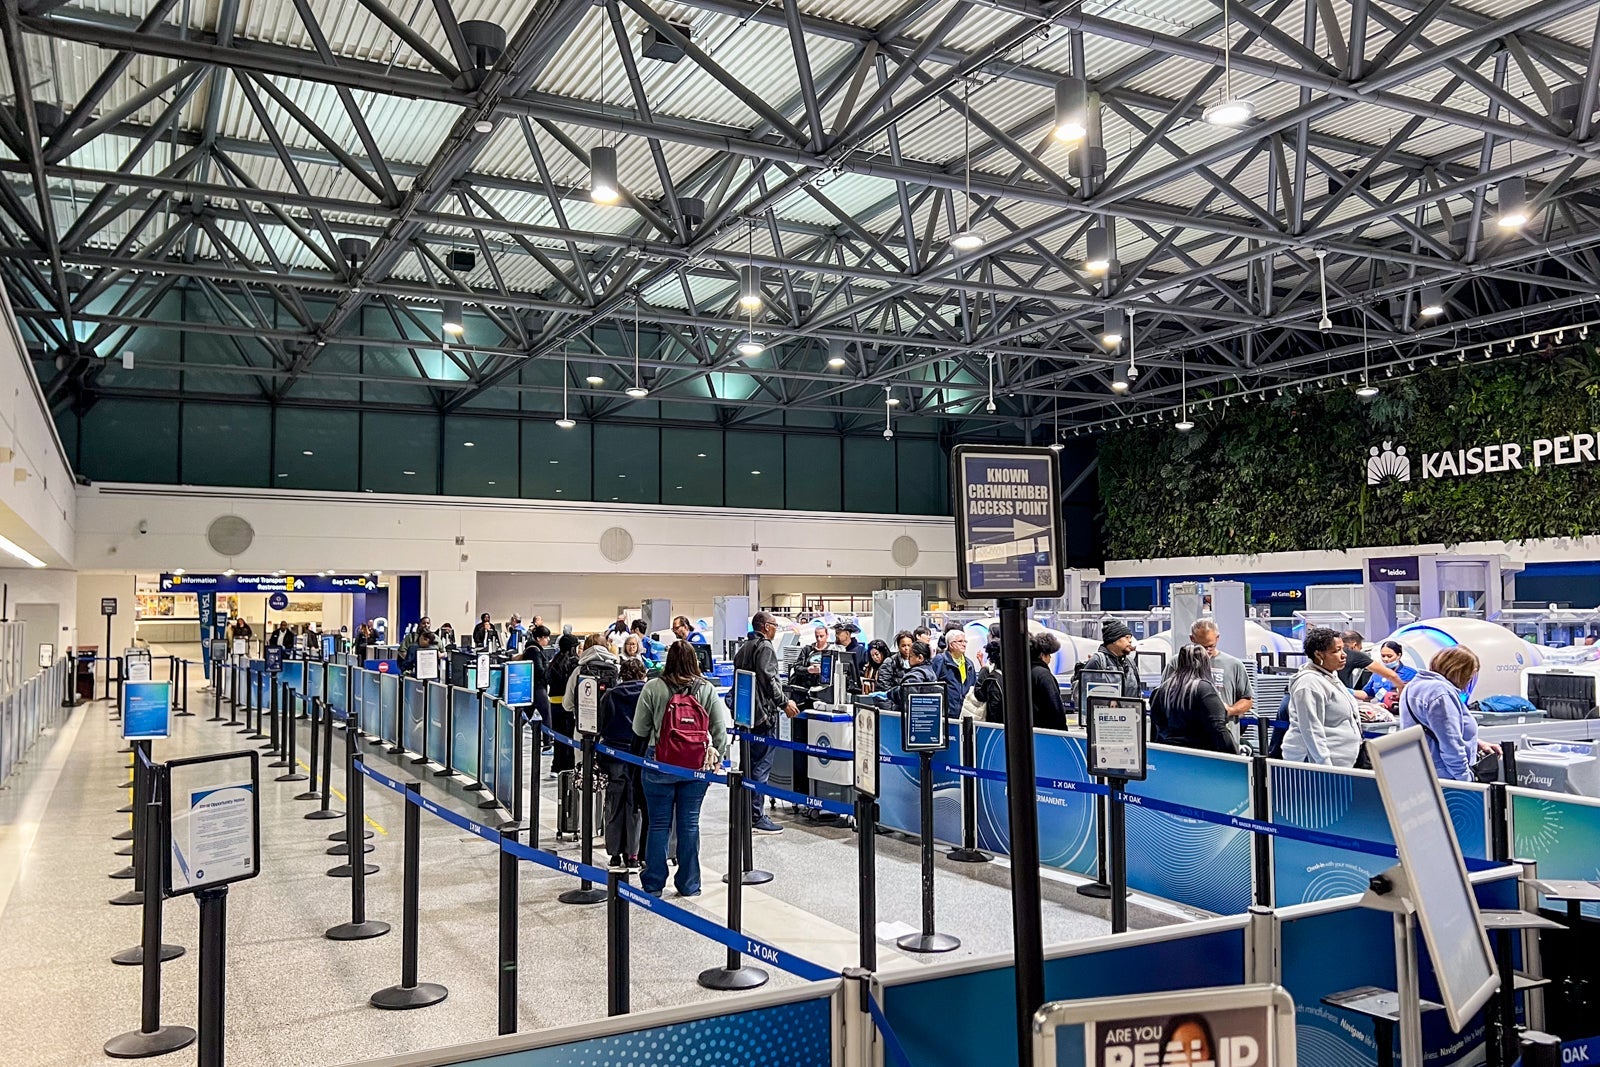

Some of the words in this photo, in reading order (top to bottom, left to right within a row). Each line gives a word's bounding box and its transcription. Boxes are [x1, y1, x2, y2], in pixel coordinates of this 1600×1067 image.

[1422, 443, 1523, 479] KAISER
[1533, 431, 1600, 467] PER
[987, 468, 1029, 483] KNOWN
[968, 484, 1048, 500] CREWMEMBER
[969, 500, 1014, 516] ACCESS
[1015, 501, 1048, 516] POINT
[1387, 568, 1407, 576] leidos
[261, 577, 287, 585] Transport
[202, 593, 210, 609] TSA
[202, 610, 210, 623] Pre
[1063, 782, 1076, 790] OAK
[1129, 795, 1142, 805] OAK
[567, 863, 579, 874] OAK
[761, 946, 779, 964] OAK
[1105, 1028, 1132, 1044] ARE
[1134, 1026, 1163, 1041] YOU
[1340, 1018, 1365, 1040] Navigate
[1219, 1035, 1259, 1067] ID
[1440, 1040, 1464, 1057] Navigate
[1562, 1044, 1589, 1064] OAK
